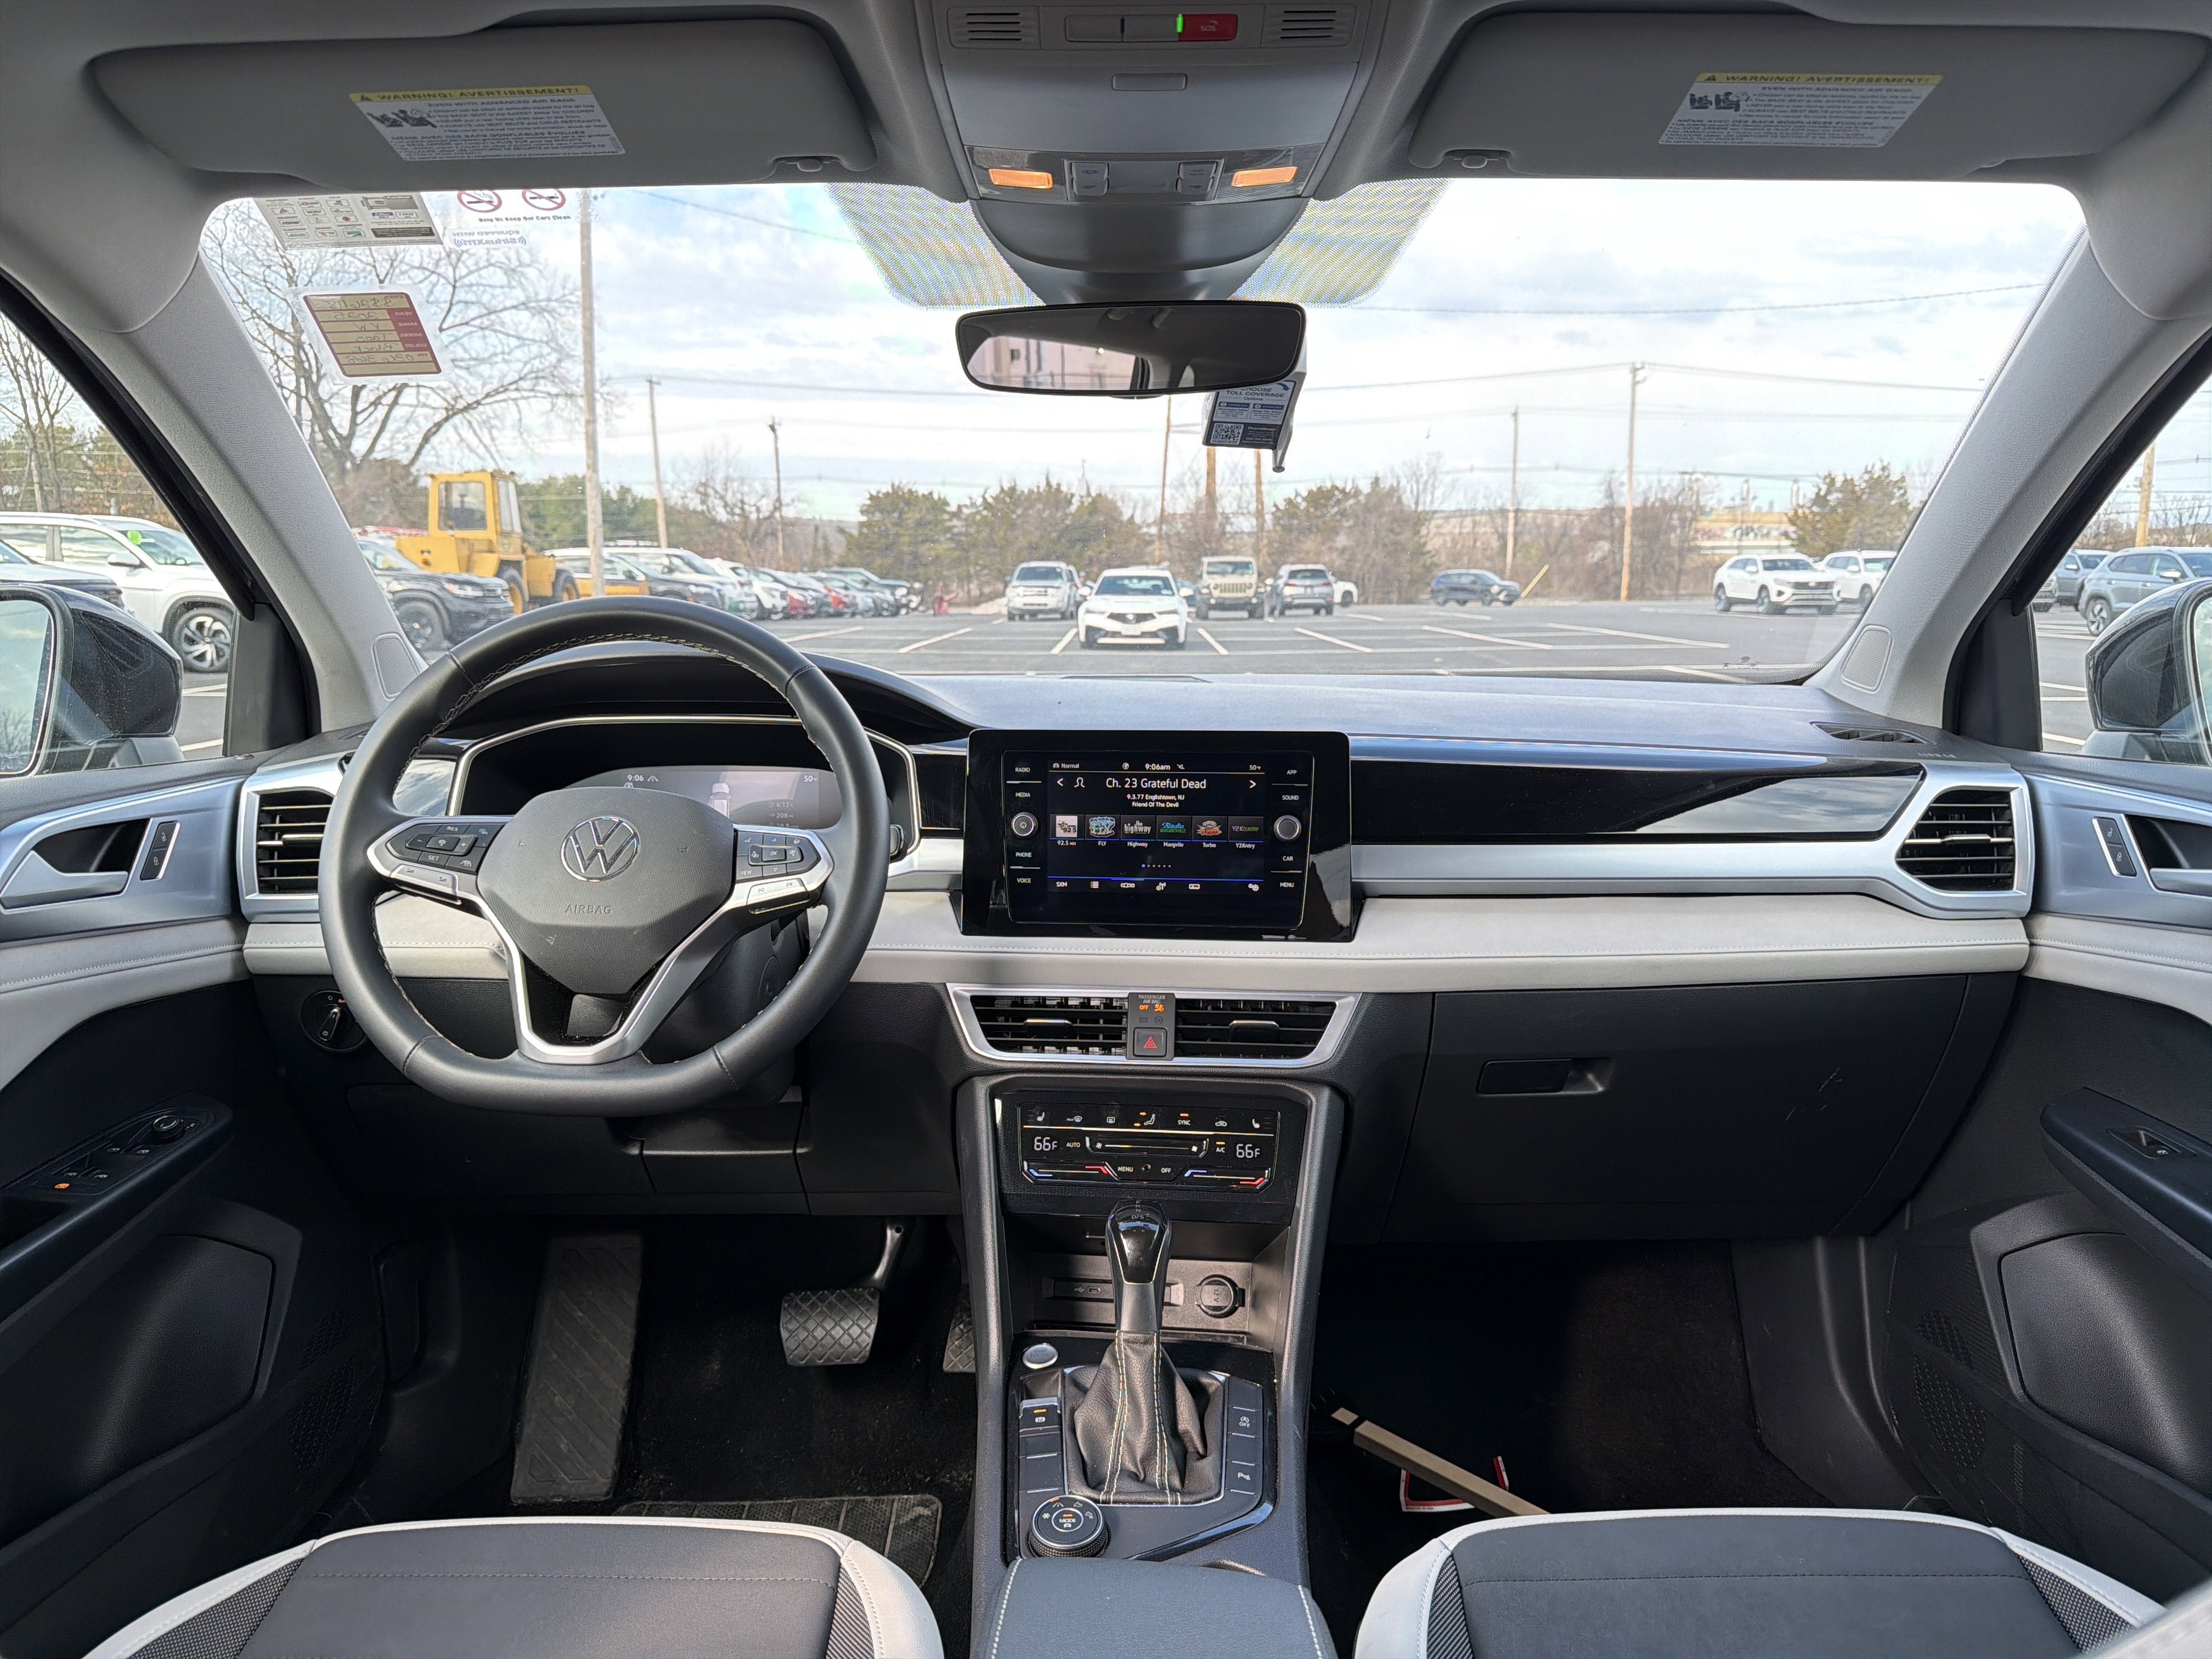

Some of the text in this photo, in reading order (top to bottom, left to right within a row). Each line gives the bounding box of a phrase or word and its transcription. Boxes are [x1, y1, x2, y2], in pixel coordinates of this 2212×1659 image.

[379, 88, 579, 100] WARNING! AVERTISSEMENT!
[1106, 777, 1206, 789] Ch. 23 Grateful Dead
[1091, 822, 1114, 835] FLY
[1124, 823, 1152, 834] highway
[565, 904, 612, 915] AIRBAG
